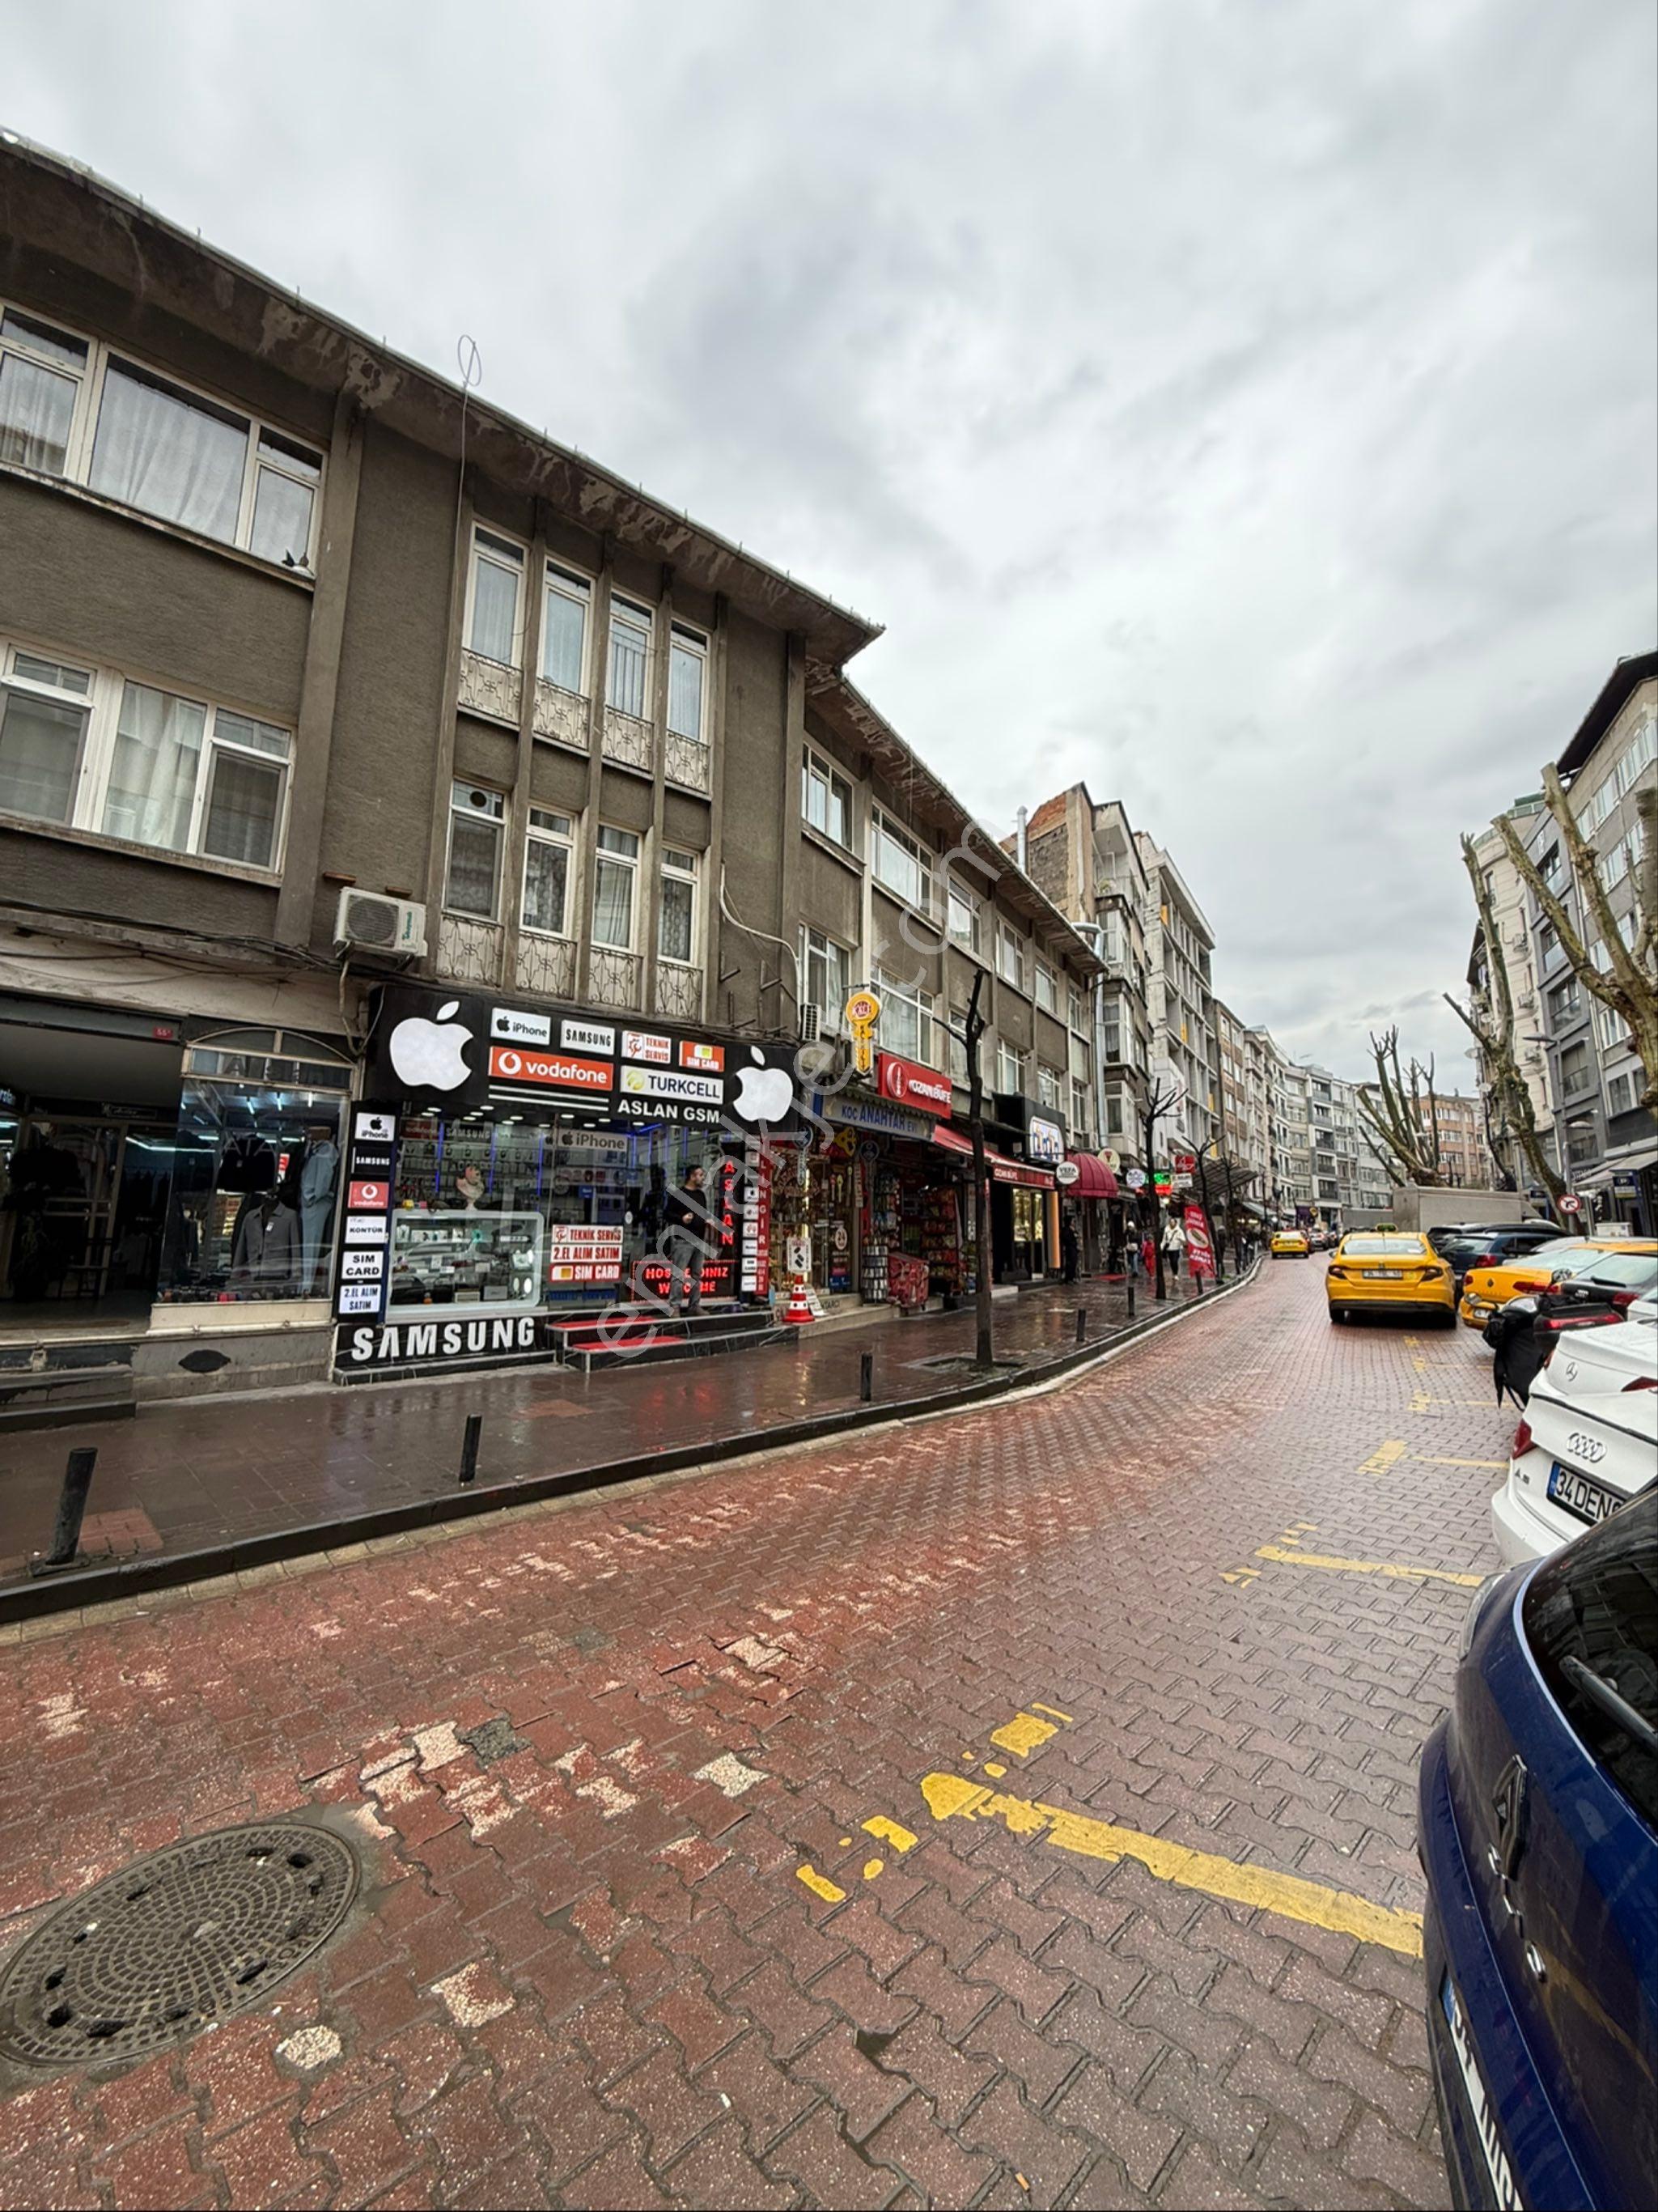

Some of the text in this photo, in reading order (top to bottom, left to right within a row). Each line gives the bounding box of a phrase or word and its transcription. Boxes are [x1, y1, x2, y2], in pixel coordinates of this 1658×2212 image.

[512, 1021, 548, 1038] iPhone
[566, 1029, 611, 1047] SAMSUNG
[526, 1062, 608, 1084] vodafone
[648, 1075, 720, 1098] TURKCELL
[617, 1099, 720, 1123] ASLAN GSM
[859, 1103, 905, 1130] ANAHTAR
[361, 1130, 389, 1139] iPhone
[445, 1127, 491, 1139] SAMSUNG
[576, 1135, 625, 1149] iPhone
[356, 1157, 390, 1165] SAMSUNG
[352, 1255, 375, 1263] SIM
[573, 1246, 593, 1260] ALIM
[595, 1246, 620, 1259] SATIM
[346, 1267, 380, 1276] CARD
[574, 1265, 620, 1280] SIM CARD
[360, 1287, 378, 1297] ALIM
[349, 1300, 371, 1311] SATIM
[351, 1317, 535, 1361] SAMSUNG
